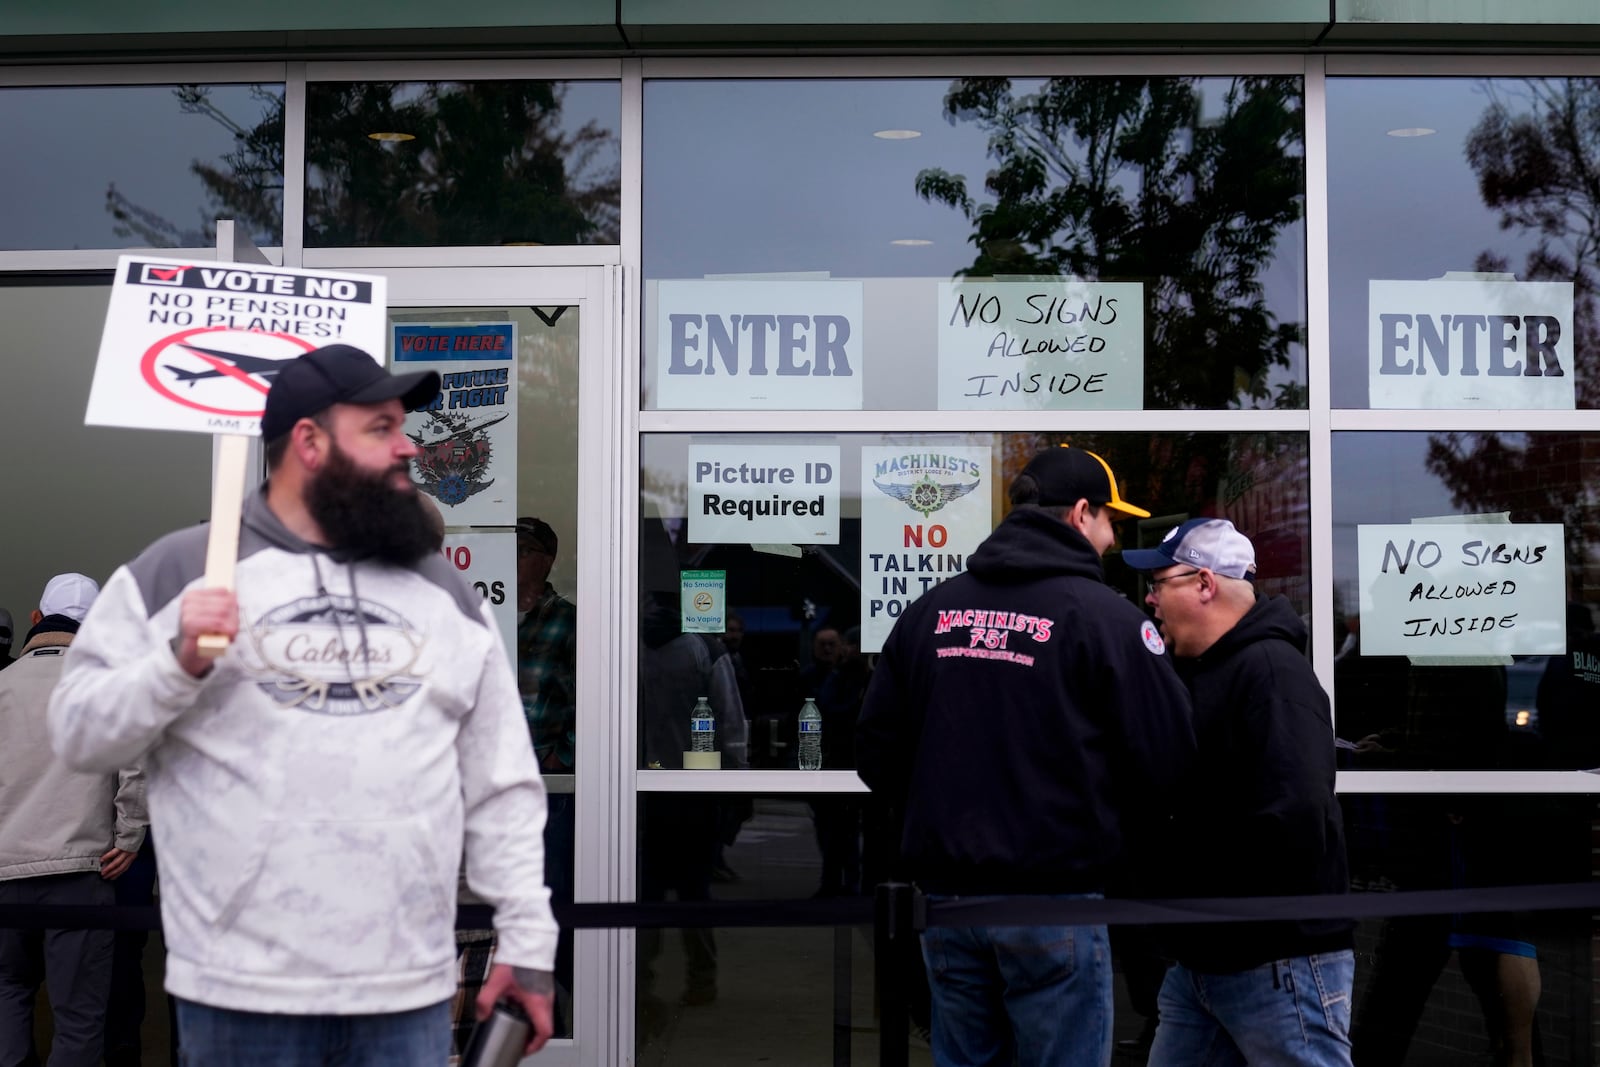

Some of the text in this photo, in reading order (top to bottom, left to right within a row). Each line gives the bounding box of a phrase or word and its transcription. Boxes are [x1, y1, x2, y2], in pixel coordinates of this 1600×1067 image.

[200, 269, 358, 301] VOTE NO
[149, 291, 346, 321] NO PENSION
[950, 293, 1118, 327] NO SIGNS
[148, 309, 343, 339] NO PLANES!
[402, 335, 506, 352] VOTE HERE
[668, 313, 853, 377] ENTER
[987, 331, 1106, 357] ALLOWED
[1379, 313, 1565, 377] ENTER
[443, 368, 509, 389] FUTURE
[964, 372, 1108, 397] INSIDE
[449, 384, 509, 409] FIGHT
[696, 462, 832, 485] Picture ID
[875, 453, 980, 478] MACHINISTS
[703, 494, 825, 521] Required
[904, 524, 948, 548] NO
[869, 554, 962, 572] TALKIN
[1381, 539, 1547, 574] NO SIGNS
[694, 581, 723, 589] Smoking
[882, 577, 907, 595] IN
[1409, 580, 1516, 601] ALLOWED
[934, 609, 1055, 642] MACHINISTS
[1403, 613, 1518, 637] INSIDE
[969, 627, 1009, 649] 751
[1573, 651, 1600, 672] BLAC
